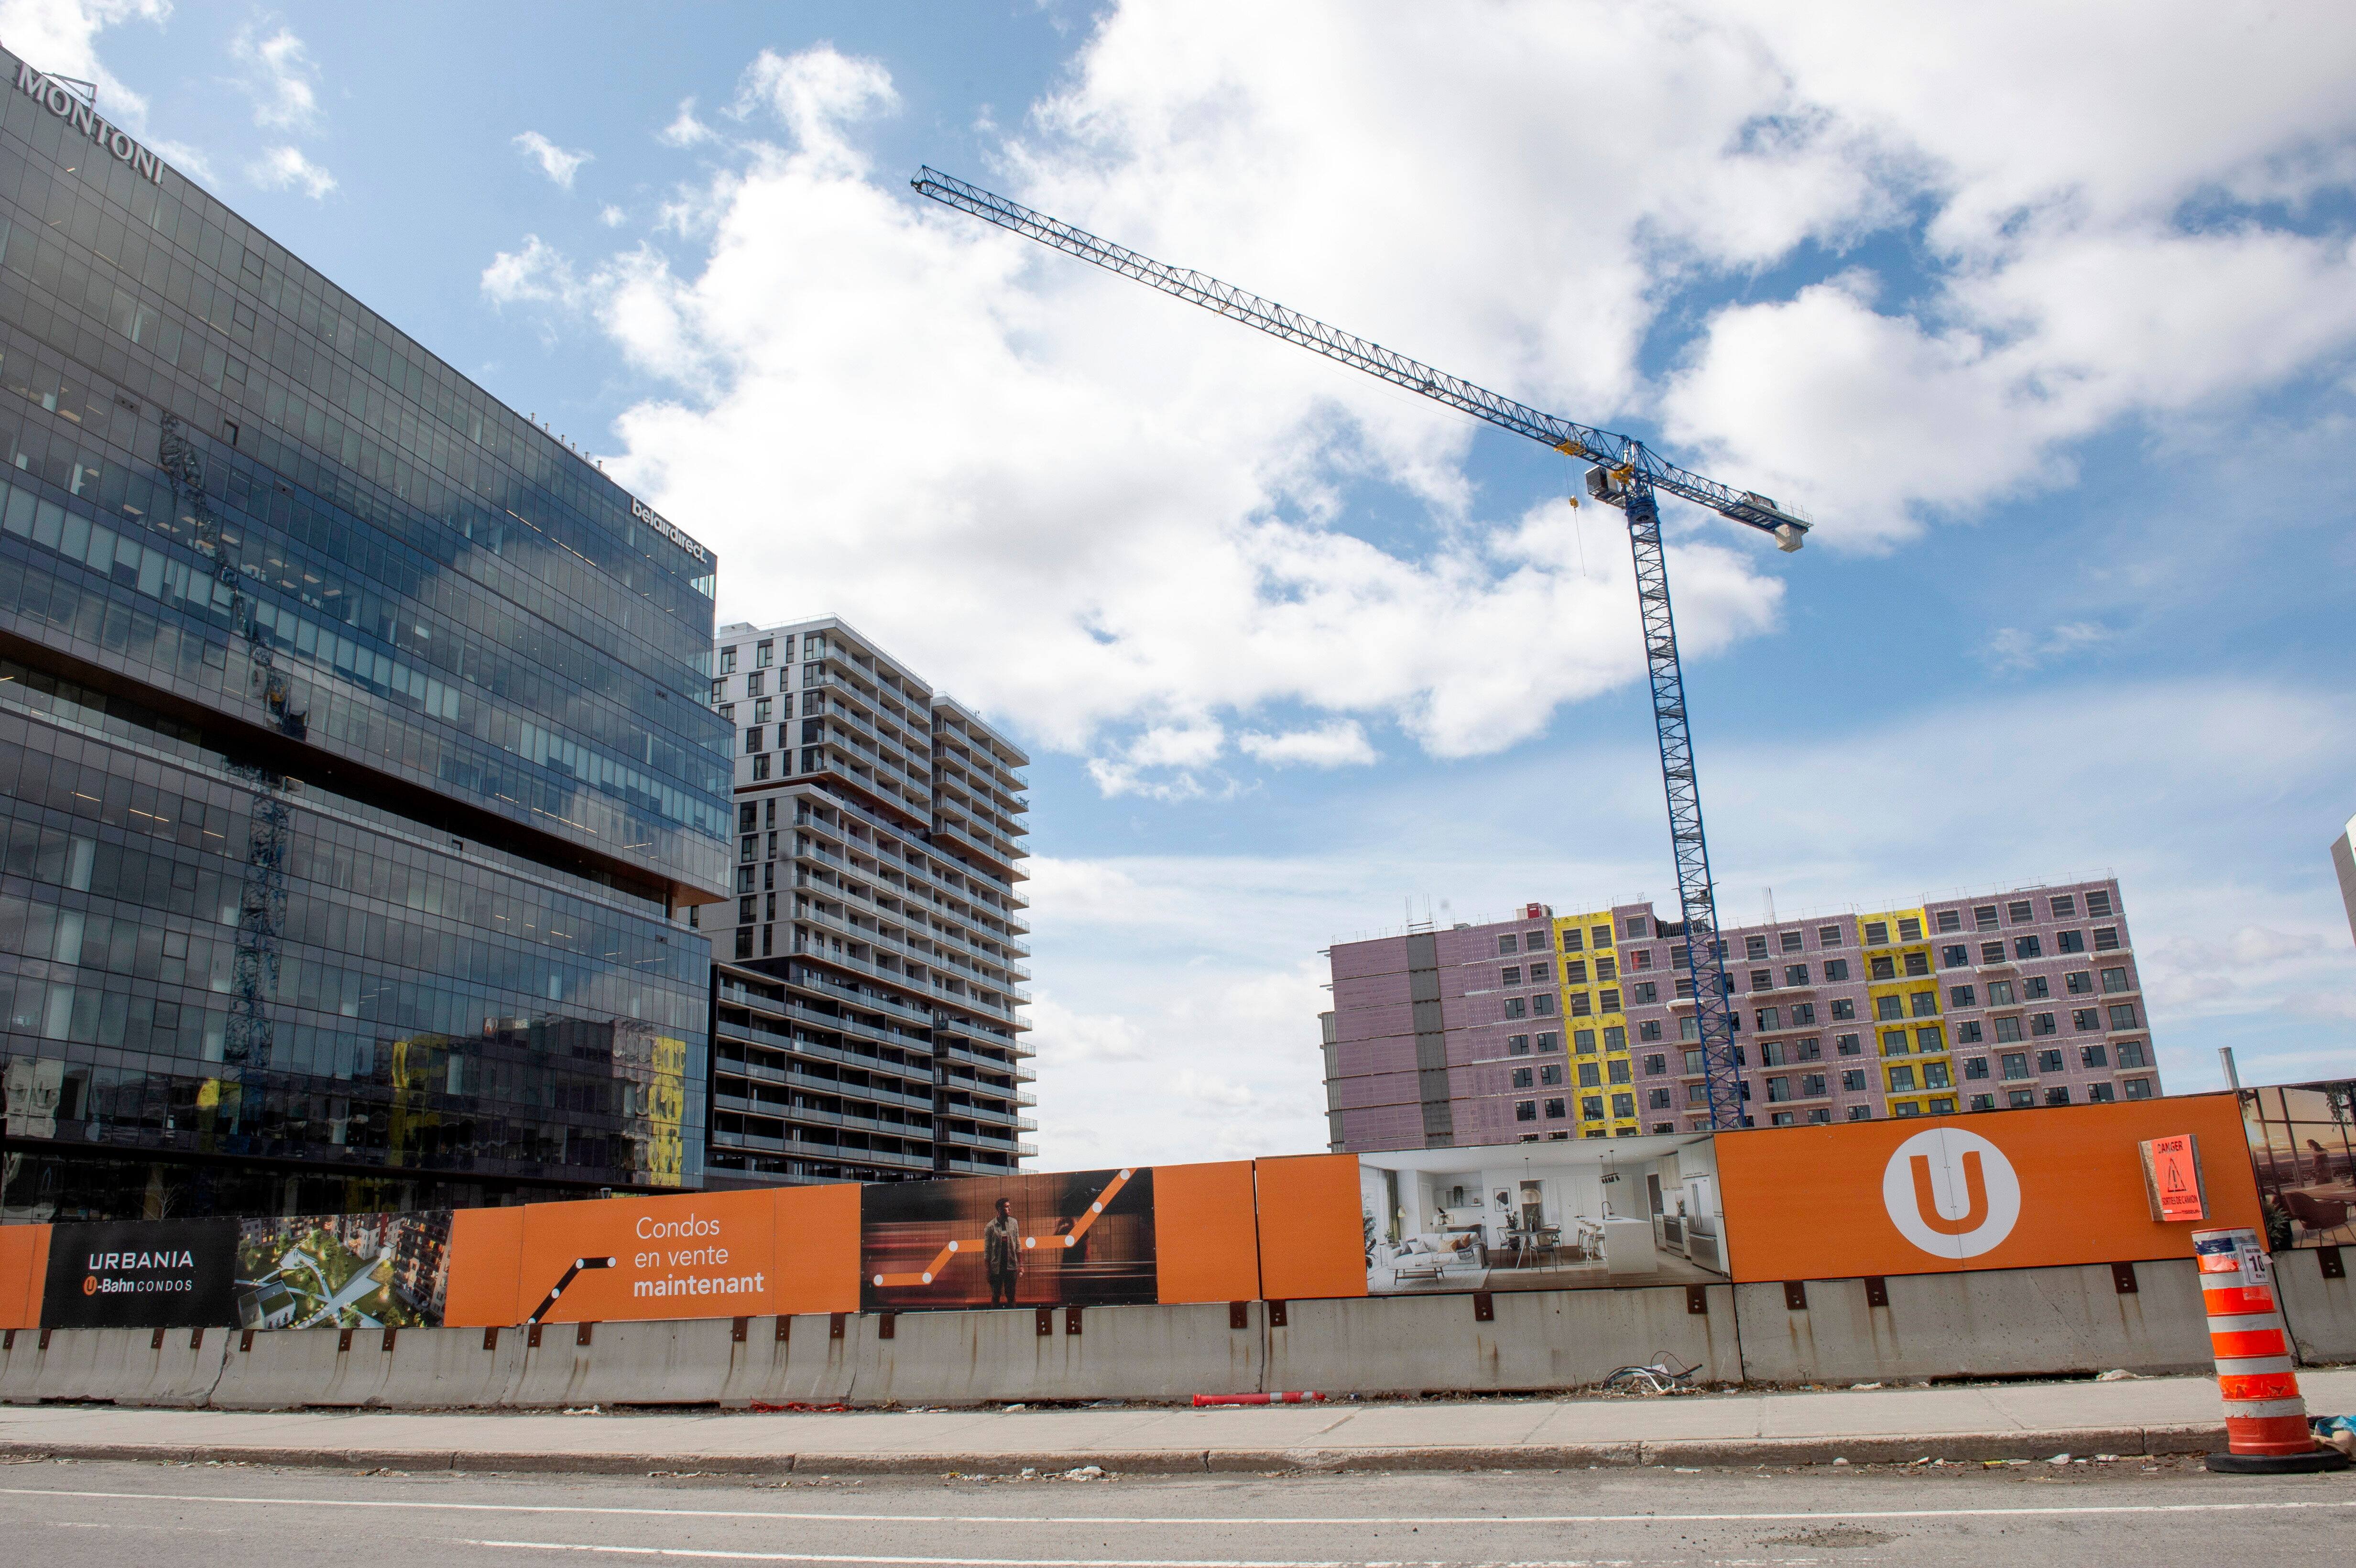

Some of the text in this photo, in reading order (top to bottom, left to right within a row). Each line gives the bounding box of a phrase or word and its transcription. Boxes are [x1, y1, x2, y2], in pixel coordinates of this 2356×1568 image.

[16, 62, 165, 185] MONTONI
[2157, 1141, 2183, 1154] DANGER
[1909, 1151, 1988, 1235] U
[636, 1214, 720, 1239] Condos
[88, 1251, 194, 1270] URBANIA
[635, 1245, 729, 1268] en vente
[2249, 1255, 2265, 1272] 10
[137, 1280, 192, 1292] CONDOS
[633, 1272, 764, 1297] maintenant
